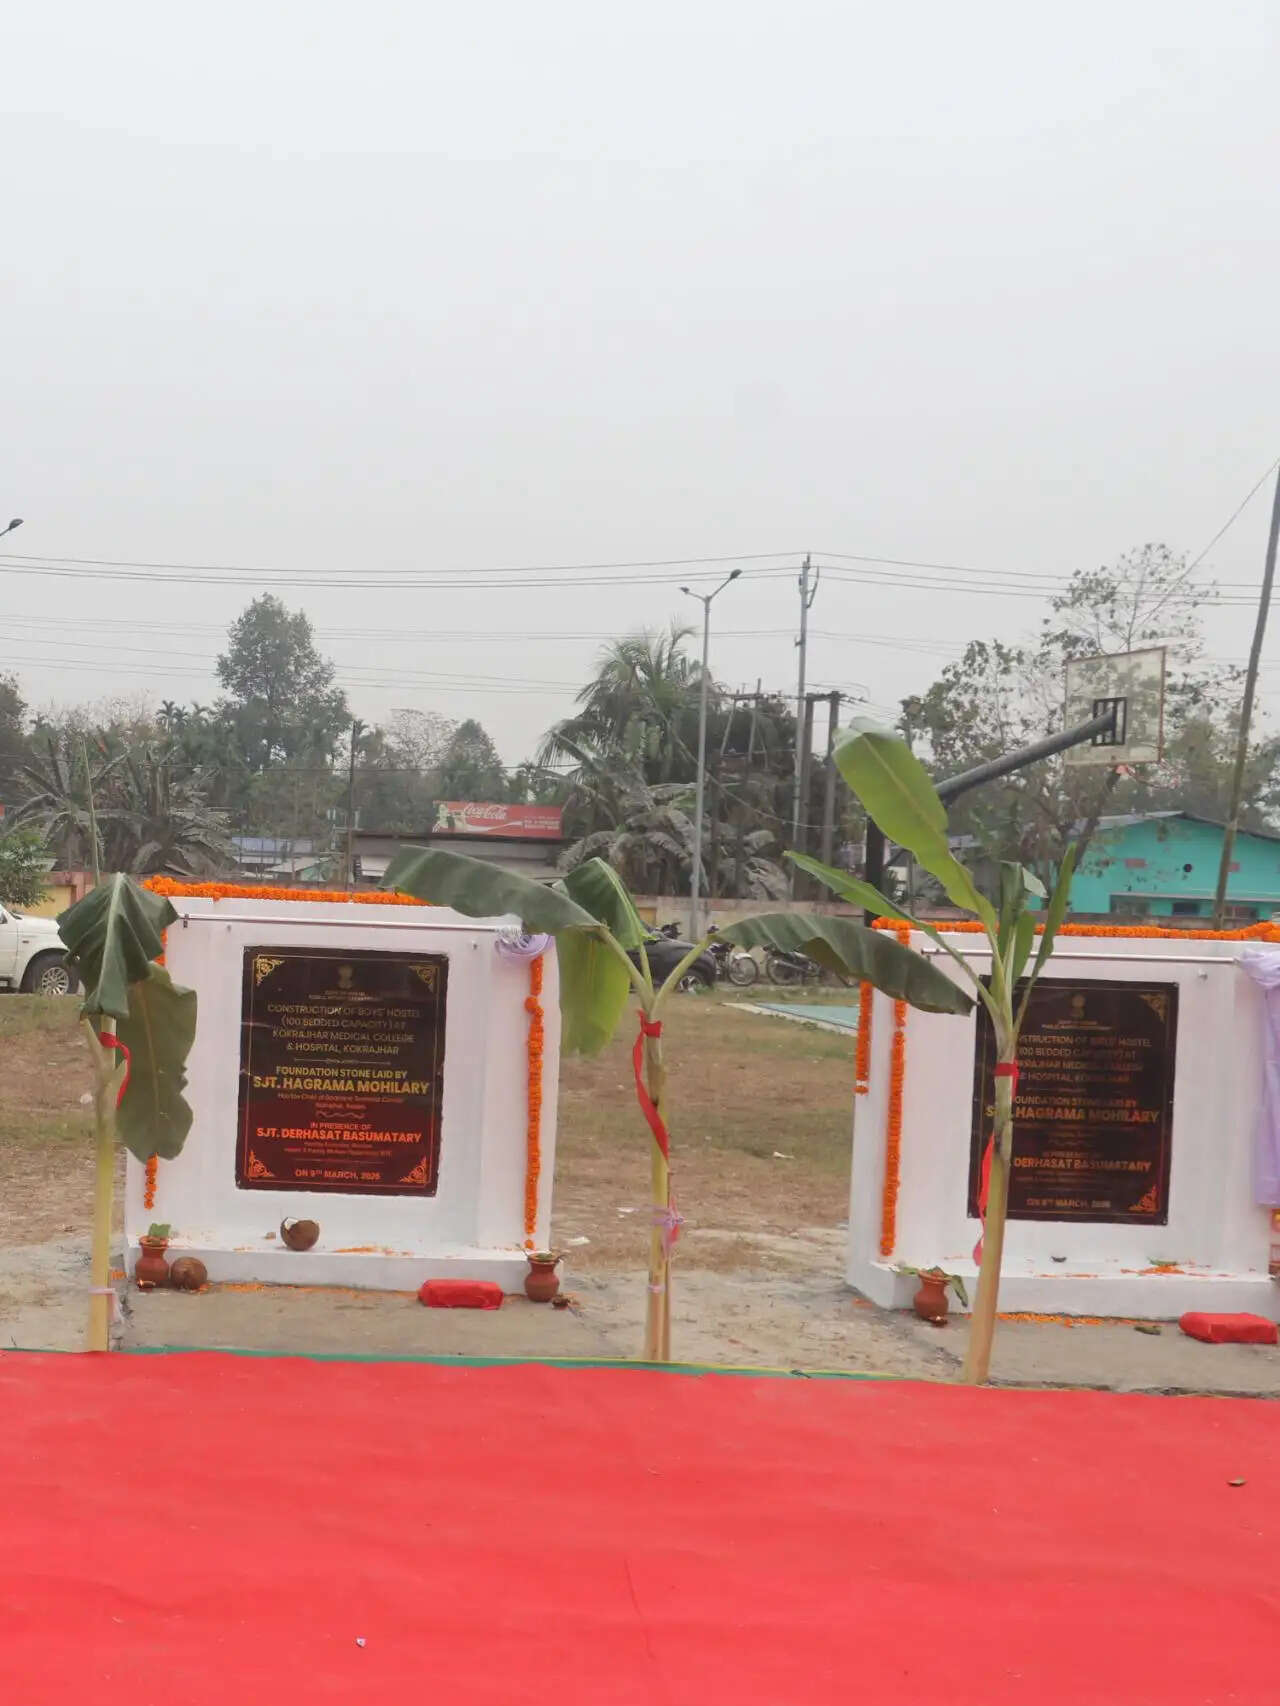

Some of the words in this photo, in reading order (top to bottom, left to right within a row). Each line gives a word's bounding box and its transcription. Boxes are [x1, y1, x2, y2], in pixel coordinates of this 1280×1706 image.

[267, 1004, 342, 1015] CONSTRUCTION
[281, 1015, 301, 1027] (100
[303, 1018, 340, 1028] BEDDED
[272, 1030, 328, 1040] KOKRAJHAR
[330, 1032, 371, 1042] MEDICAL
[373, 1033, 415, 1043] COLLEGE
[286, 1041, 295, 1050] &
[343, 1044, 399, 1055] KOKRAJHAR
[276, 1066, 338, 1077] FOUNDATION
[340, 1068, 370, 1078] STONE
[372, 1070, 393, 1079] LAID
[395, 1070, 408, 1079] BY
[253, 1076, 281, 1088] SJT.
[283, 1077, 354, 1091] HAGRAMA
[357, 1081, 429, 1095] MOHILARY
[1015, 1096, 1069, 1106] OUNDATION
[1016, 1106, 1086, 1120] HAGRAMA
[1089, 1109, 1160, 1123] MOHILARY
[319, 1122, 359, 1130] PRESENCE
[256, 1128, 280, 1138] SJT.
[281, 1129, 342, 1141] DERHASAT
[344, 1131, 421, 1143] BASUMATARY
[1014, 1157, 1071, 1169] DERHASAT
[295, 1169, 308, 1177] ON
[324, 1171, 359, 1180] MARCH,
